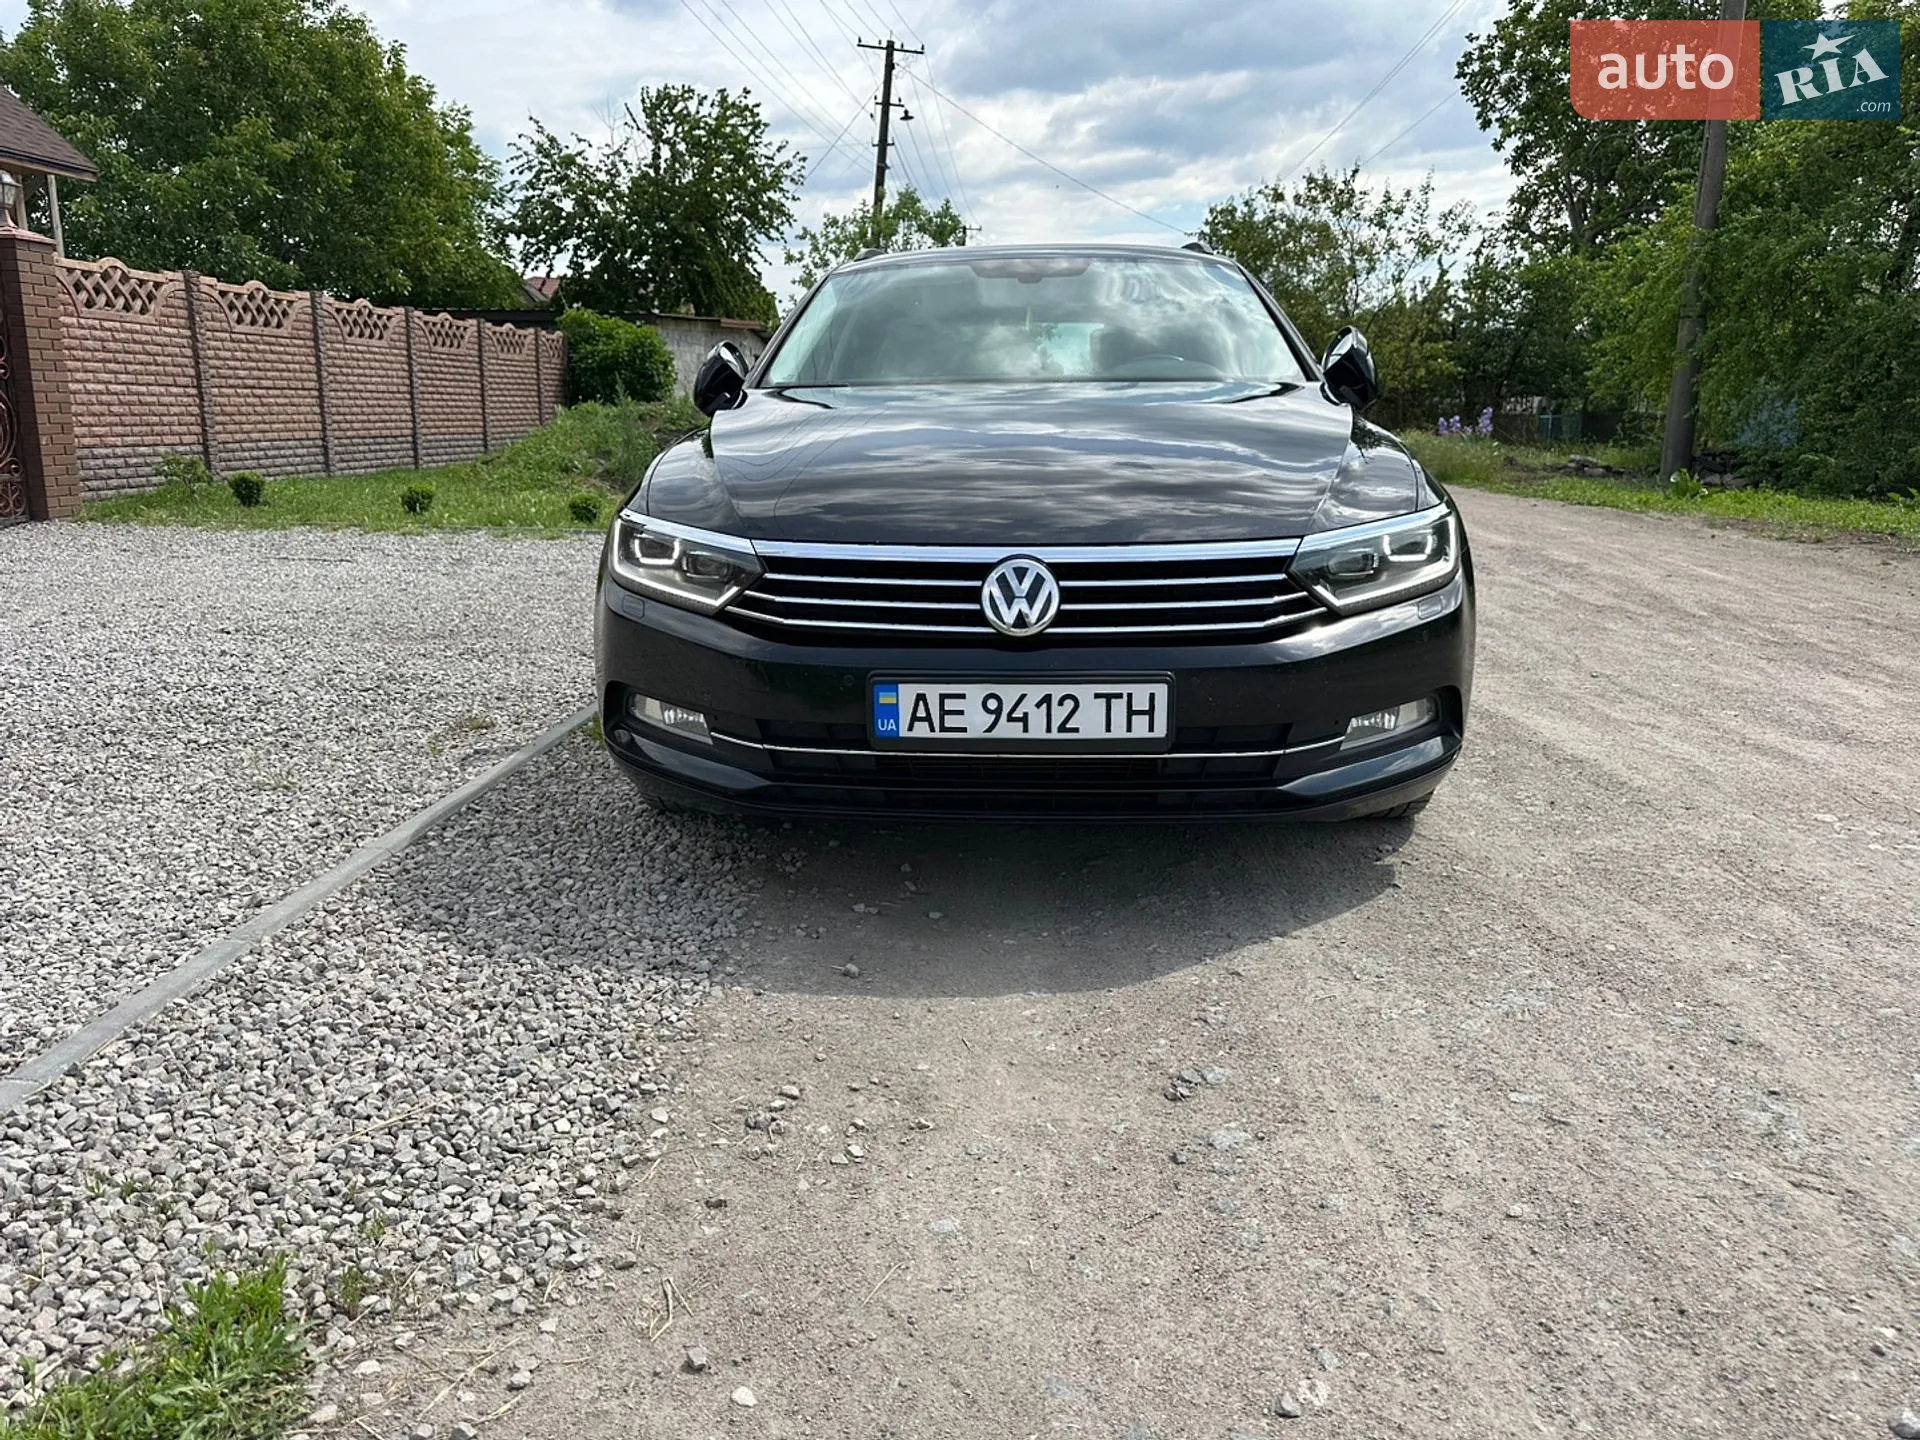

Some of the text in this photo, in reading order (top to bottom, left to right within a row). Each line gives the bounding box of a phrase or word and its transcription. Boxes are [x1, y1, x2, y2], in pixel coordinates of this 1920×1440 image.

[983, 560, 1058, 635] VW
[878, 718, 897, 731] UA
[907, 692, 1155, 733] AE 9412 TH
